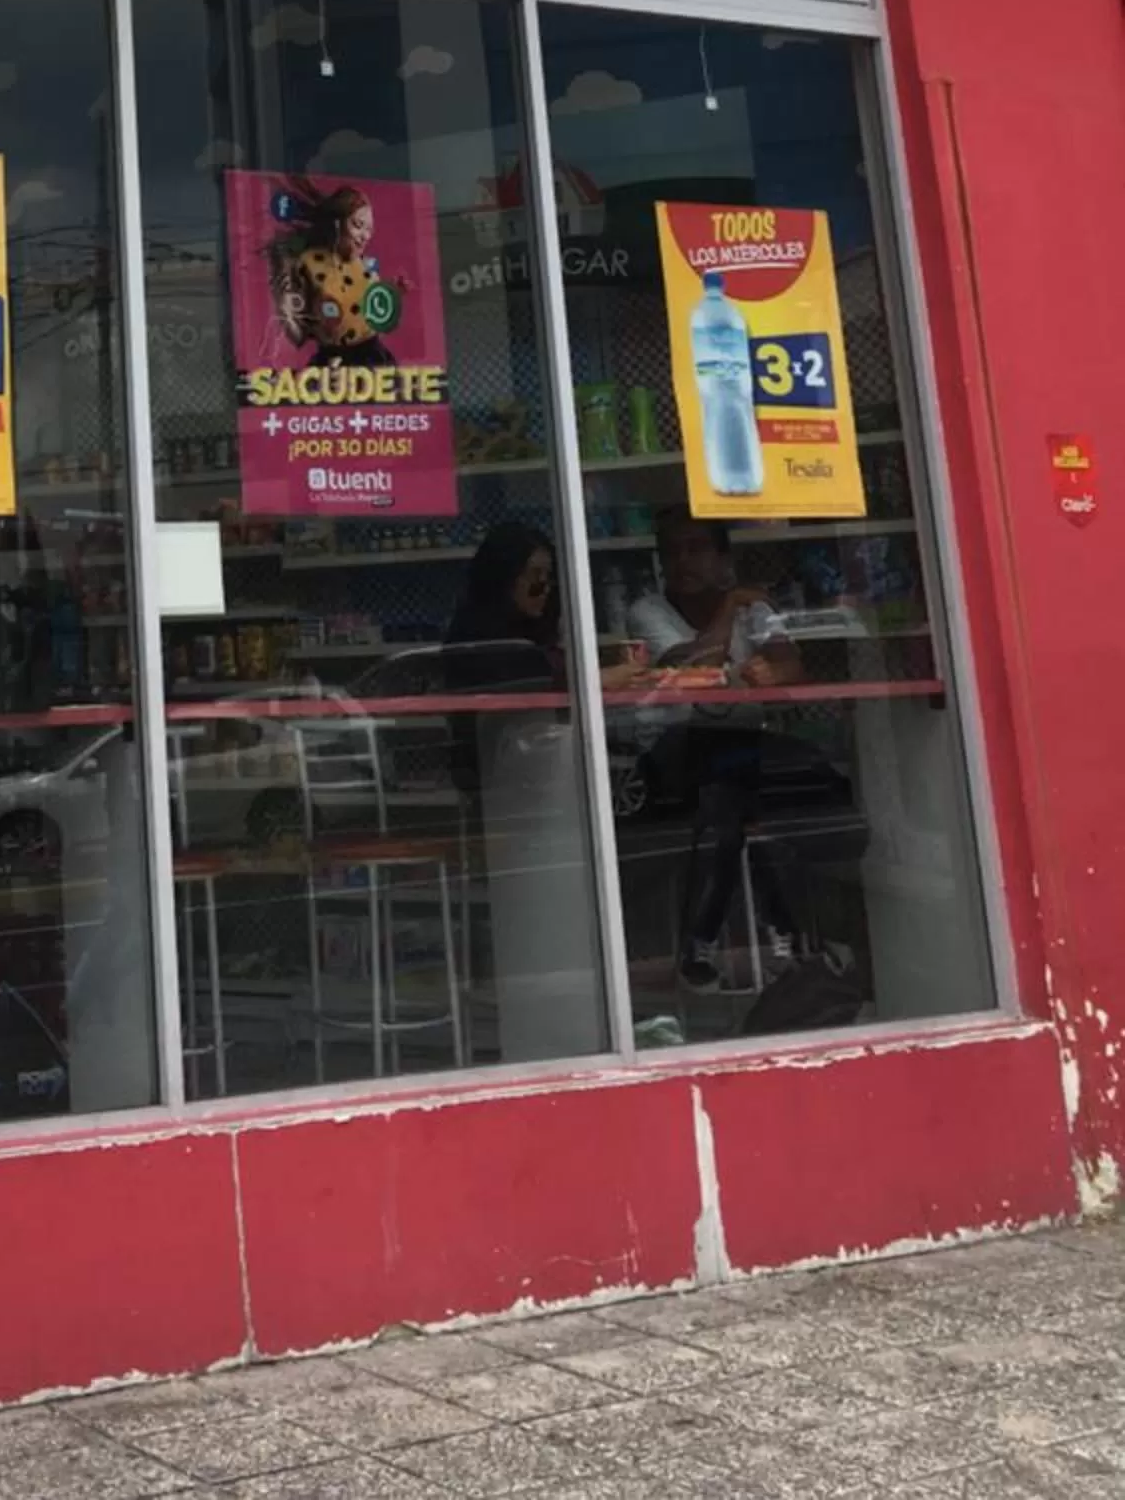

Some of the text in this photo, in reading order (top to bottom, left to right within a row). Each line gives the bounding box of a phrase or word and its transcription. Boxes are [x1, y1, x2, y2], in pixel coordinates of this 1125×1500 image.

[710, 209, 776, 243] TODOS
[506, 248, 629, 280] HGAR
[688, 246, 718, 267] LOS
[247, 357, 443, 405] SACÚDETE
[287, 416, 345, 434] GIGAS
[371, 414, 430, 432] REDES
[338, 438, 362, 456] 30
[327, 469, 392, 491] tuenti
